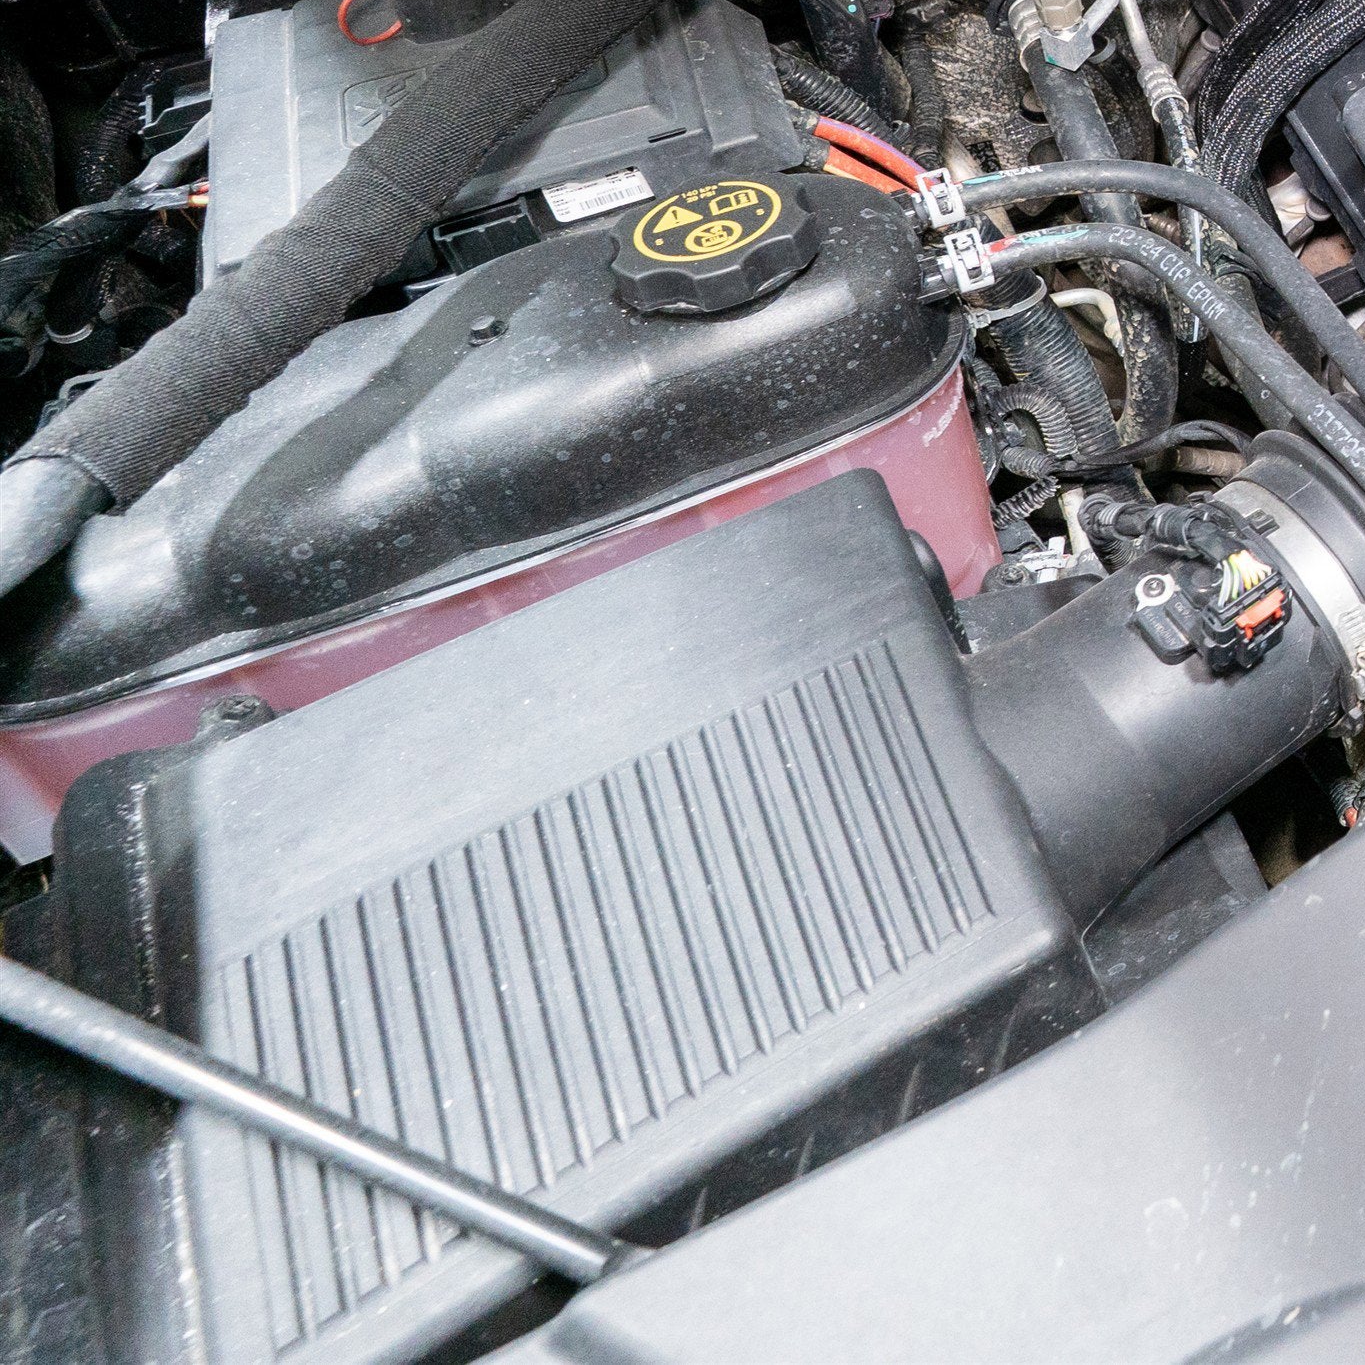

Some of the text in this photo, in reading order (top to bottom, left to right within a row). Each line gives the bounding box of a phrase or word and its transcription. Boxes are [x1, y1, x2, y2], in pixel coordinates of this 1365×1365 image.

[681, 189, 699, 199] 140
[686, 190, 716, 203] 20 PSI
